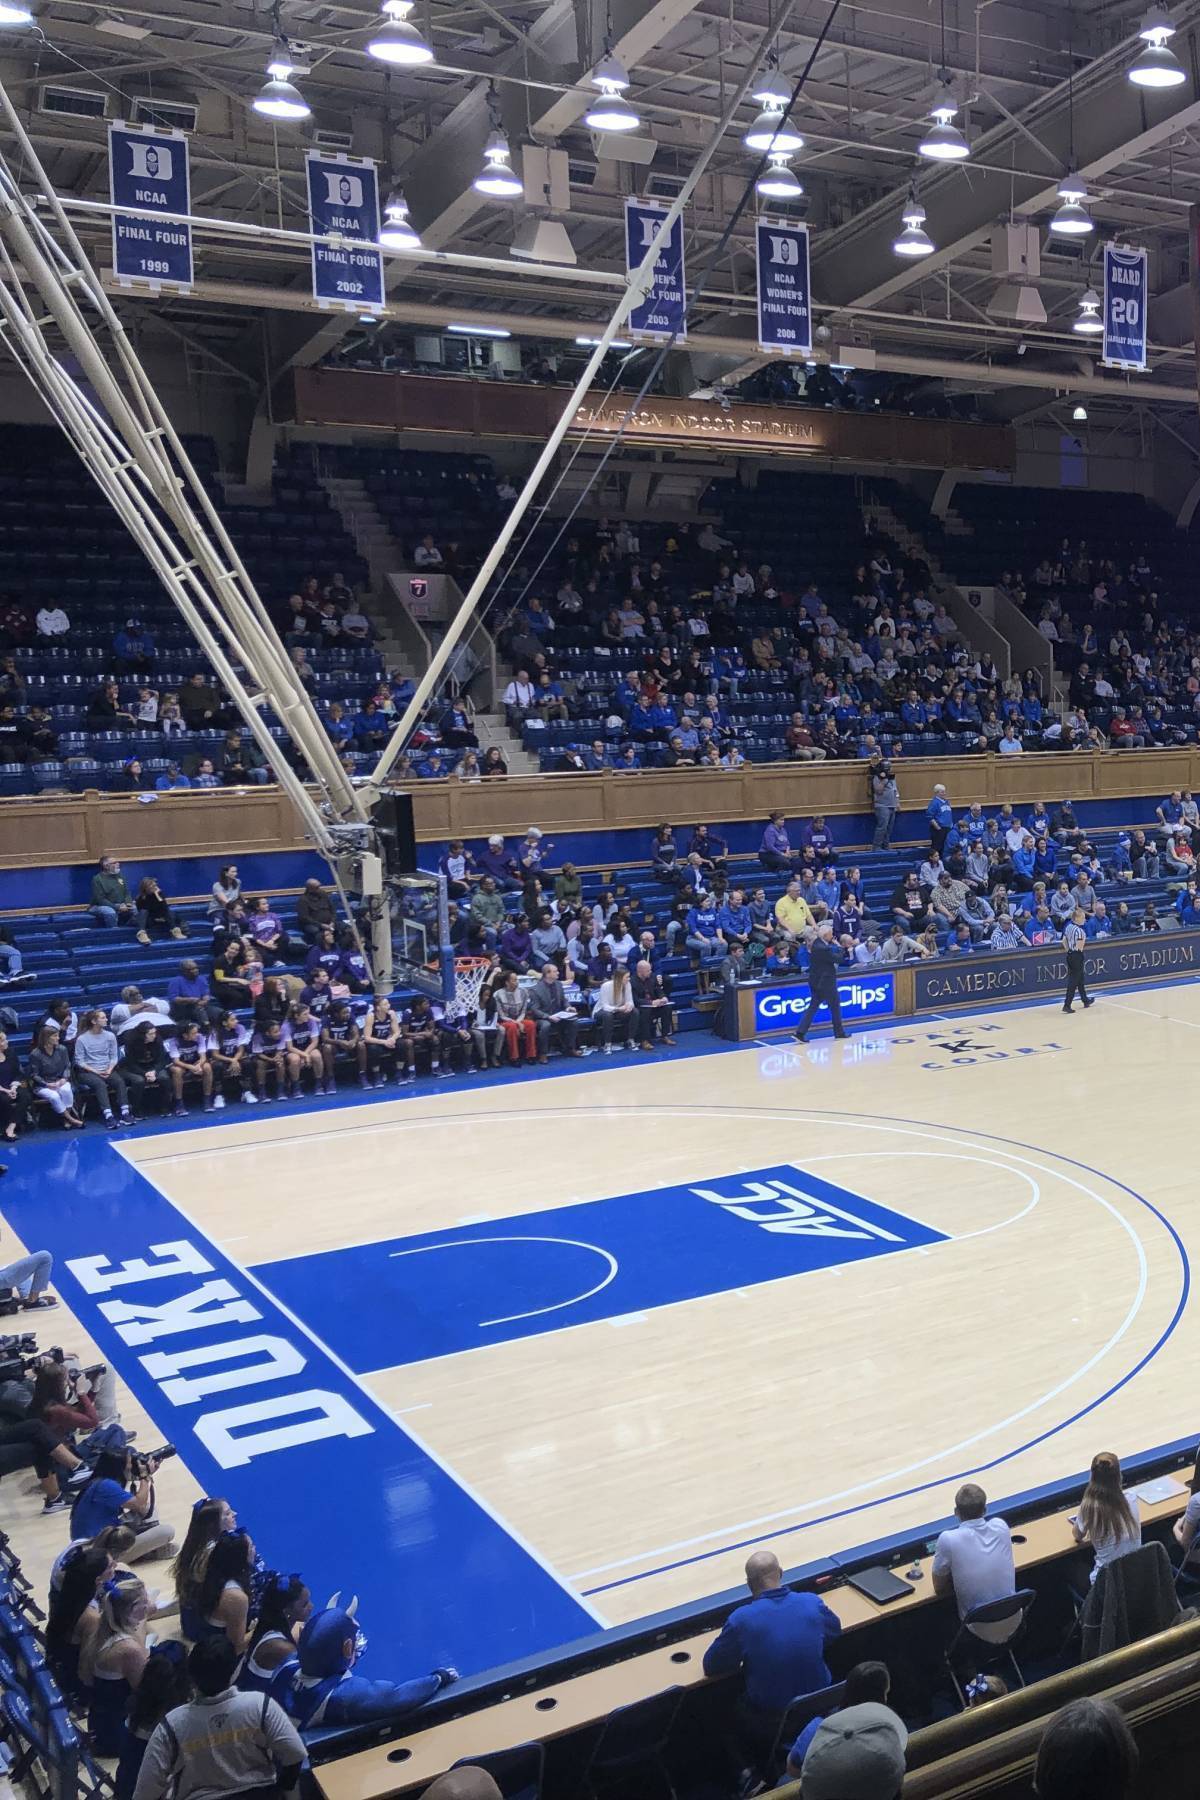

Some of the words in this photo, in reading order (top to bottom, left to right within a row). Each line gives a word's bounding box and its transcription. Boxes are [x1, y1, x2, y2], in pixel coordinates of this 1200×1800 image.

[136, 190, 167, 204] NCAA
[332, 216, 360, 230] NCAA
[119, 226, 152, 242] FINAL
[156, 231, 187, 246] FOUR
[140, 259, 169, 273] 1999
[318, 250, 347, 264] FINAL
[350, 255, 378, 268] FOUR
[774, 273, 796, 284] NCAA
[1112, 266, 1140, 286] BEARD
[336, 280, 363, 294] 2002
[658, 290, 681, 302] FOUR
[766, 288, 803, 301] WOMEN'S
[763, 302, 786, 314] FINAL
[788, 305, 807, 316] FOUR
[1112, 297, 1139, 325] 20
[648, 314, 669, 326] 2003
[576, 407, 663, 428] CAMERON
[670, 414, 736, 432] INDOOR
[741, 420, 814, 439] STADIUM
[414, 584, 422, 594] 7
[848, 922, 854, 933] 1
[926, 968, 1025, 998] CAMERON
[1036, 959, 1108, 982] INDOR
[1120, 946, 1194, 971] STADIUM
[929, 1039, 996, 1054] K
[920, 1042, 1063, 1070] COURT
[688, 1182, 876, 1240] ACC
[65, 1239, 376, 1470] DUKE
